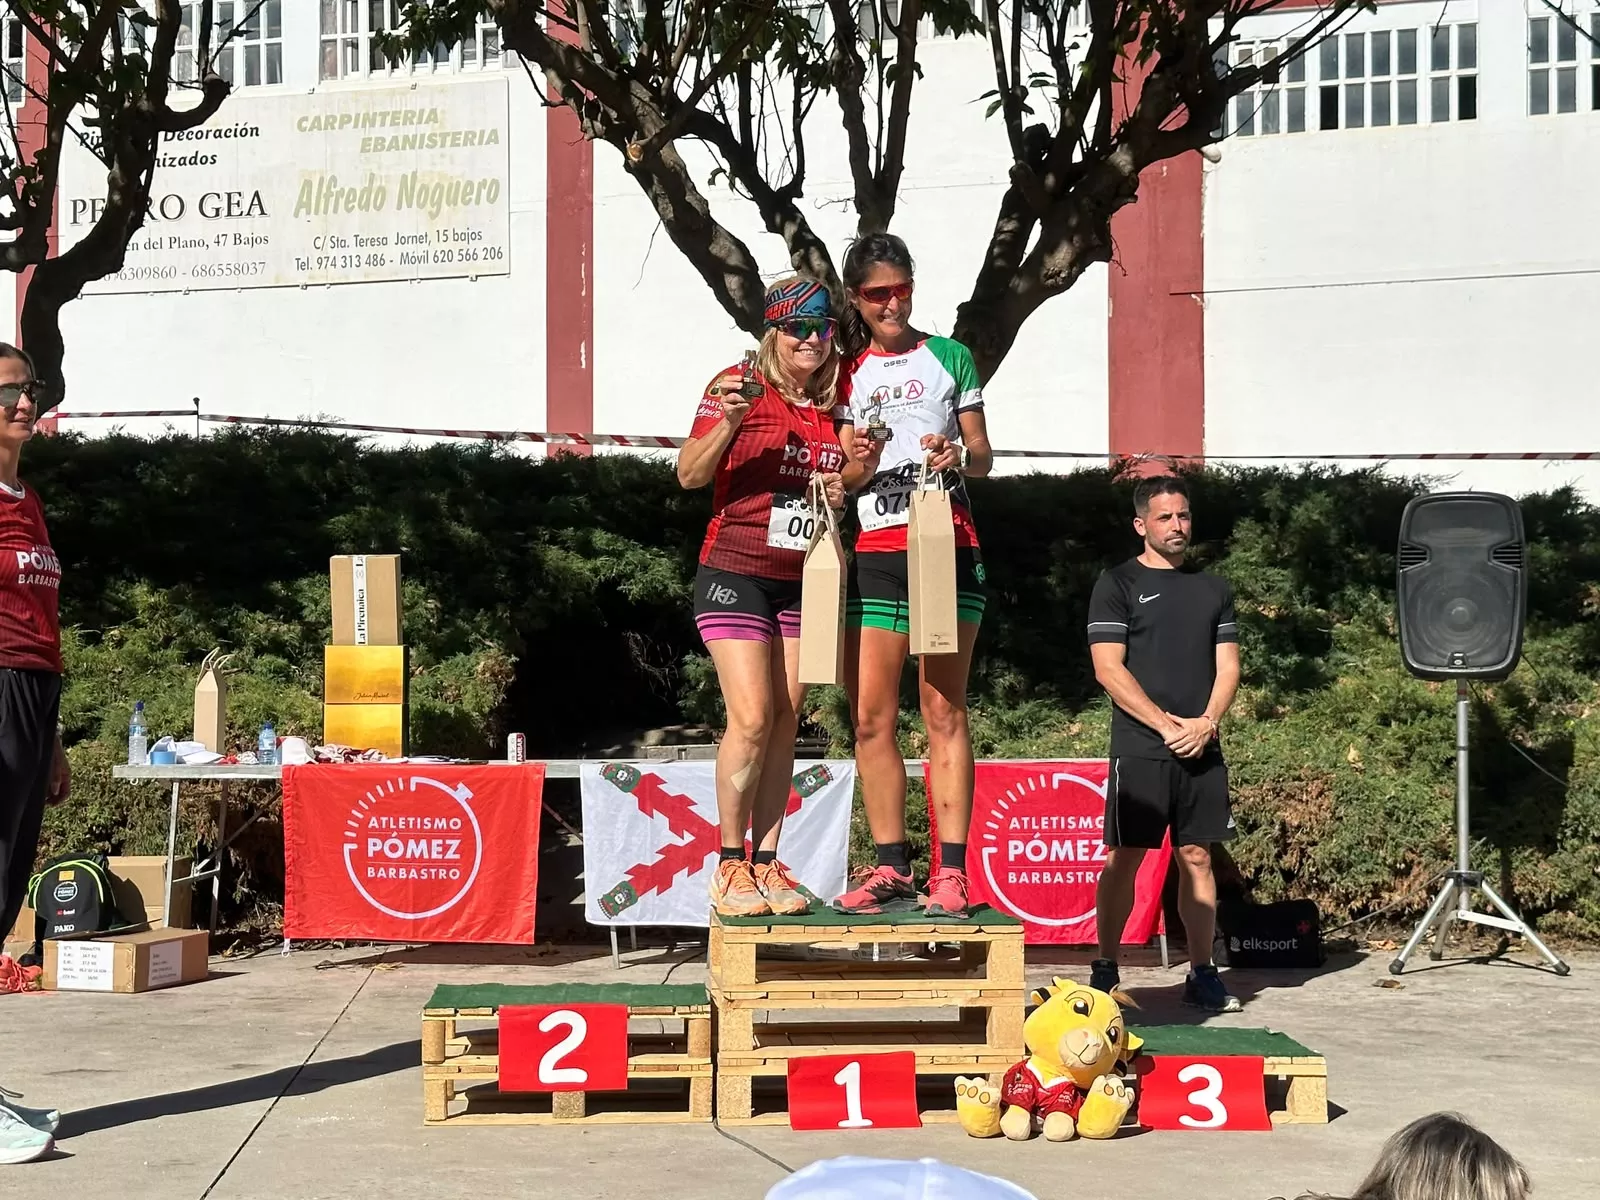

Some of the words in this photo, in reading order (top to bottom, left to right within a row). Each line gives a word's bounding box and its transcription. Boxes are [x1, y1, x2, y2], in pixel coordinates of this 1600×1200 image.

[163, 121, 260, 143] Decoración
[296, 108, 439, 133] CARPINTERIA
[359, 128, 500, 154] EBANISTERIA
[154, 150, 218, 168] nizados
[293, 172, 387, 219] Alfredo
[396, 170, 501, 221] Noguero
[69, 193, 185, 226] PERO
[198, 190, 269, 219] GEA
[144, 236, 163, 250] del
[168, 234, 209, 250] Plano,
[213, 233, 228, 248] 47
[233, 231, 269, 249] Bajos
[313, 235, 327, 251] C/
[329, 235, 350, 249] Sta.
[353, 233, 388, 248] Teresa
[394, 231, 432, 247] Jornet,
[436, 229, 449, 243] 15
[452, 227, 483, 246] bajos
[192, 261, 266, 278] 686558037
[295, 256, 313, 271] Tel.
[316, 255, 337, 269] 974
[340, 253, 361, 268] 313
[365, 252, 386, 267] 486
[399, 250, 429, 266] Móvil
[433, 248, 454, 263] 620
[457, 247, 478, 262] 566
[482, 246, 503, 261] 206
[779, 465, 817, 479] BARBA
[788, 516, 815, 540] 00
[16, 546, 61, 576] PÓME
[18, 574, 60, 589] BARBASTR
[357, 633, 366, 645] La
[368, 816, 462, 830] ATLETISMO
[367, 831, 461, 860] PÓMEZ
[1008, 832, 1108, 862] PÓMEZ
[367, 866, 460, 880] BARBASTRO
[1242, 937, 1298, 952] elksport
[537, 1009, 589, 1084] 2
[833, 1061, 873, 1128] 1
[1177, 1063, 1228, 1128] 3
